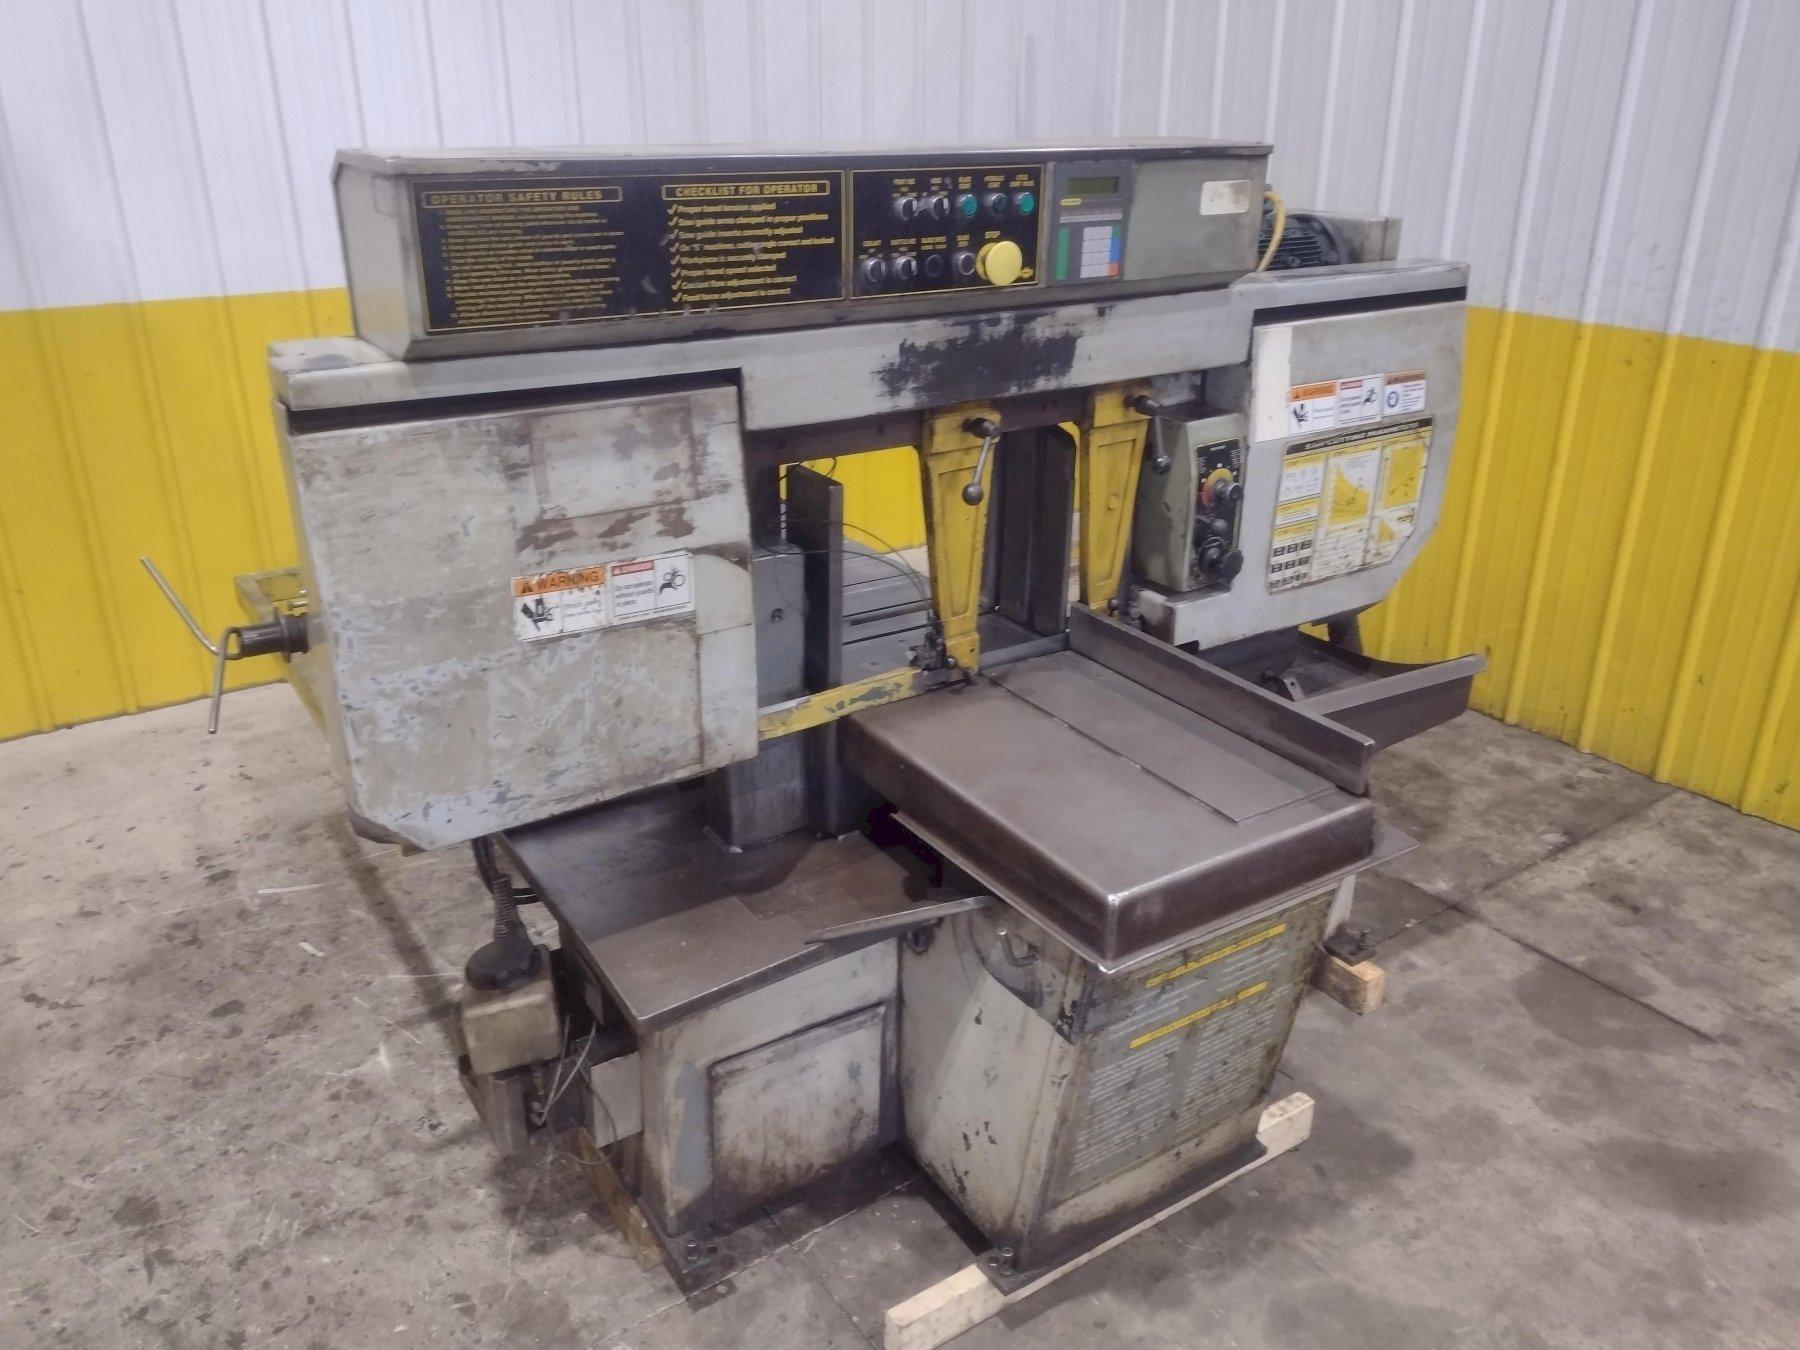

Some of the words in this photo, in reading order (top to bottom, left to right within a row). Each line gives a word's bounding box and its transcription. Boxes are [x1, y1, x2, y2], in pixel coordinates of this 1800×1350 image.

[431, 193, 504, 205] OPERATOR
[509, 191, 558, 203] SAFETY
[562, 190, 603, 201] RULES
[676, 186, 735, 197] CHECKLIST
[739, 185, 760, 195] FOR
[764, 184, 818, 194] OPERATOR
[984, 231, 1001, 239] STOP
[537, 571, 600, 590] WARNING
